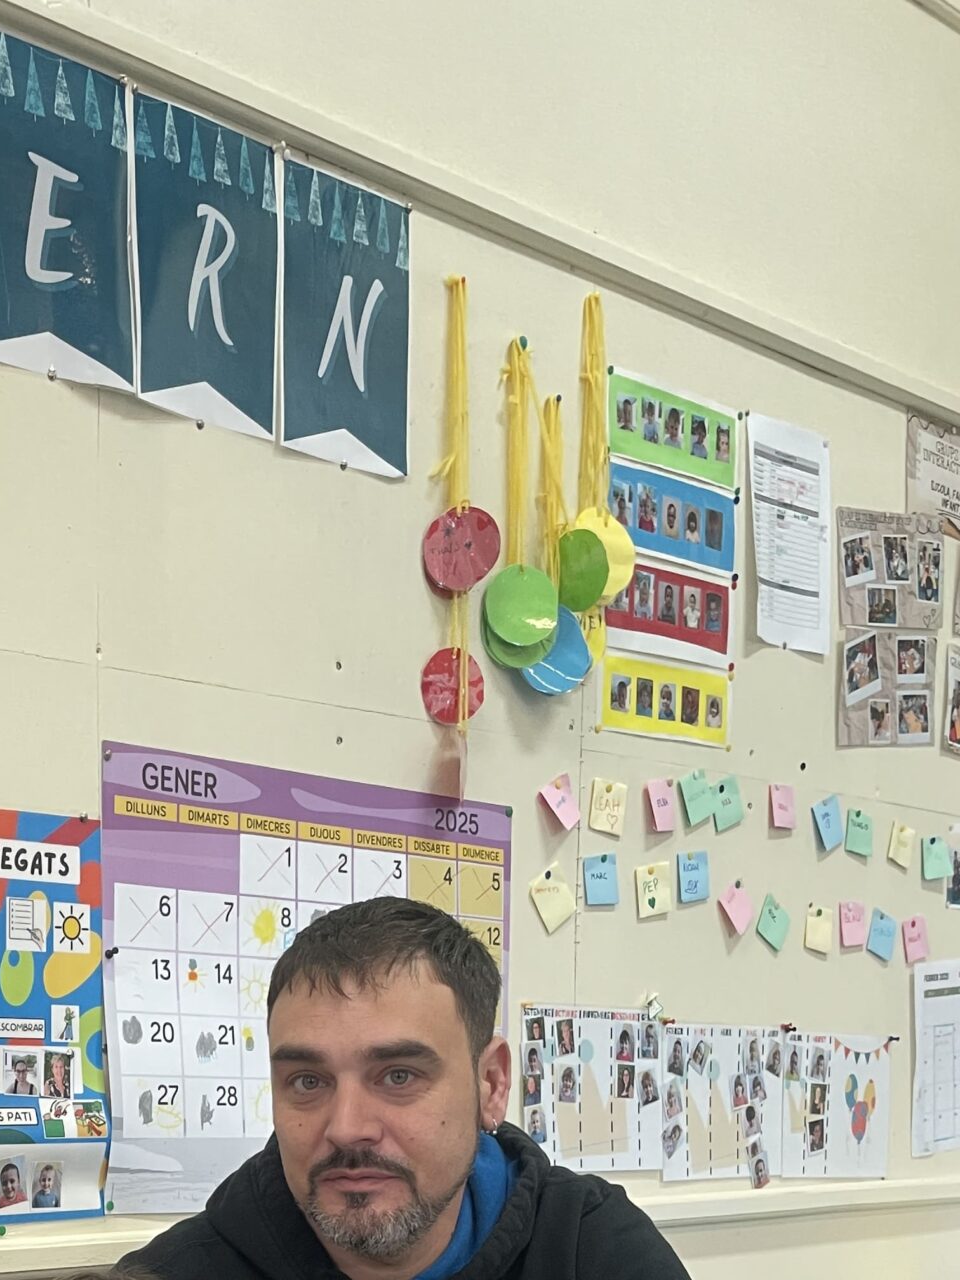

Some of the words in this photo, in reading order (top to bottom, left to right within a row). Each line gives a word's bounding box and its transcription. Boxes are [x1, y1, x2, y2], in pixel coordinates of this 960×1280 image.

[142, 762, 218, 799] GENER
[125, 800, 167, 817] DILLUNS
[187, 809, 230, 826] DIMARTS
[246, 817, 291, 834] DIMECRES
[356, 833, 404, 849] DIVENDRES
[413, 840, 451, 856] DISSABTE
[462, 847, 500, 862] DIUMENGE
[434, 807, 480, 836] 2025
[284, 846, 292, 868] 1
[337, 853, 348, 874] 2
[392, 860, 403, 880] 3
[443, 866, 453, 886] 4
[491, 872, 501, 891] 5
[642, 877, 659, 895] PEP
[158, 895, 171, 917] 6
[223, 901, 234, 922] 7
[280, 907, 291, 928] 8
[486, 926, 501, 946] 12
[151, 958, 171, 981] 13
[214, 963, 233, 984] 14
[150, 1021, 175, 1044] 20
[217, 1024, 235, 1046] 21
[157, 1084, 179, 1106] 27
[216, 1085, 238, 1107] 28
[8, 1111, 32, 1122] PATI
